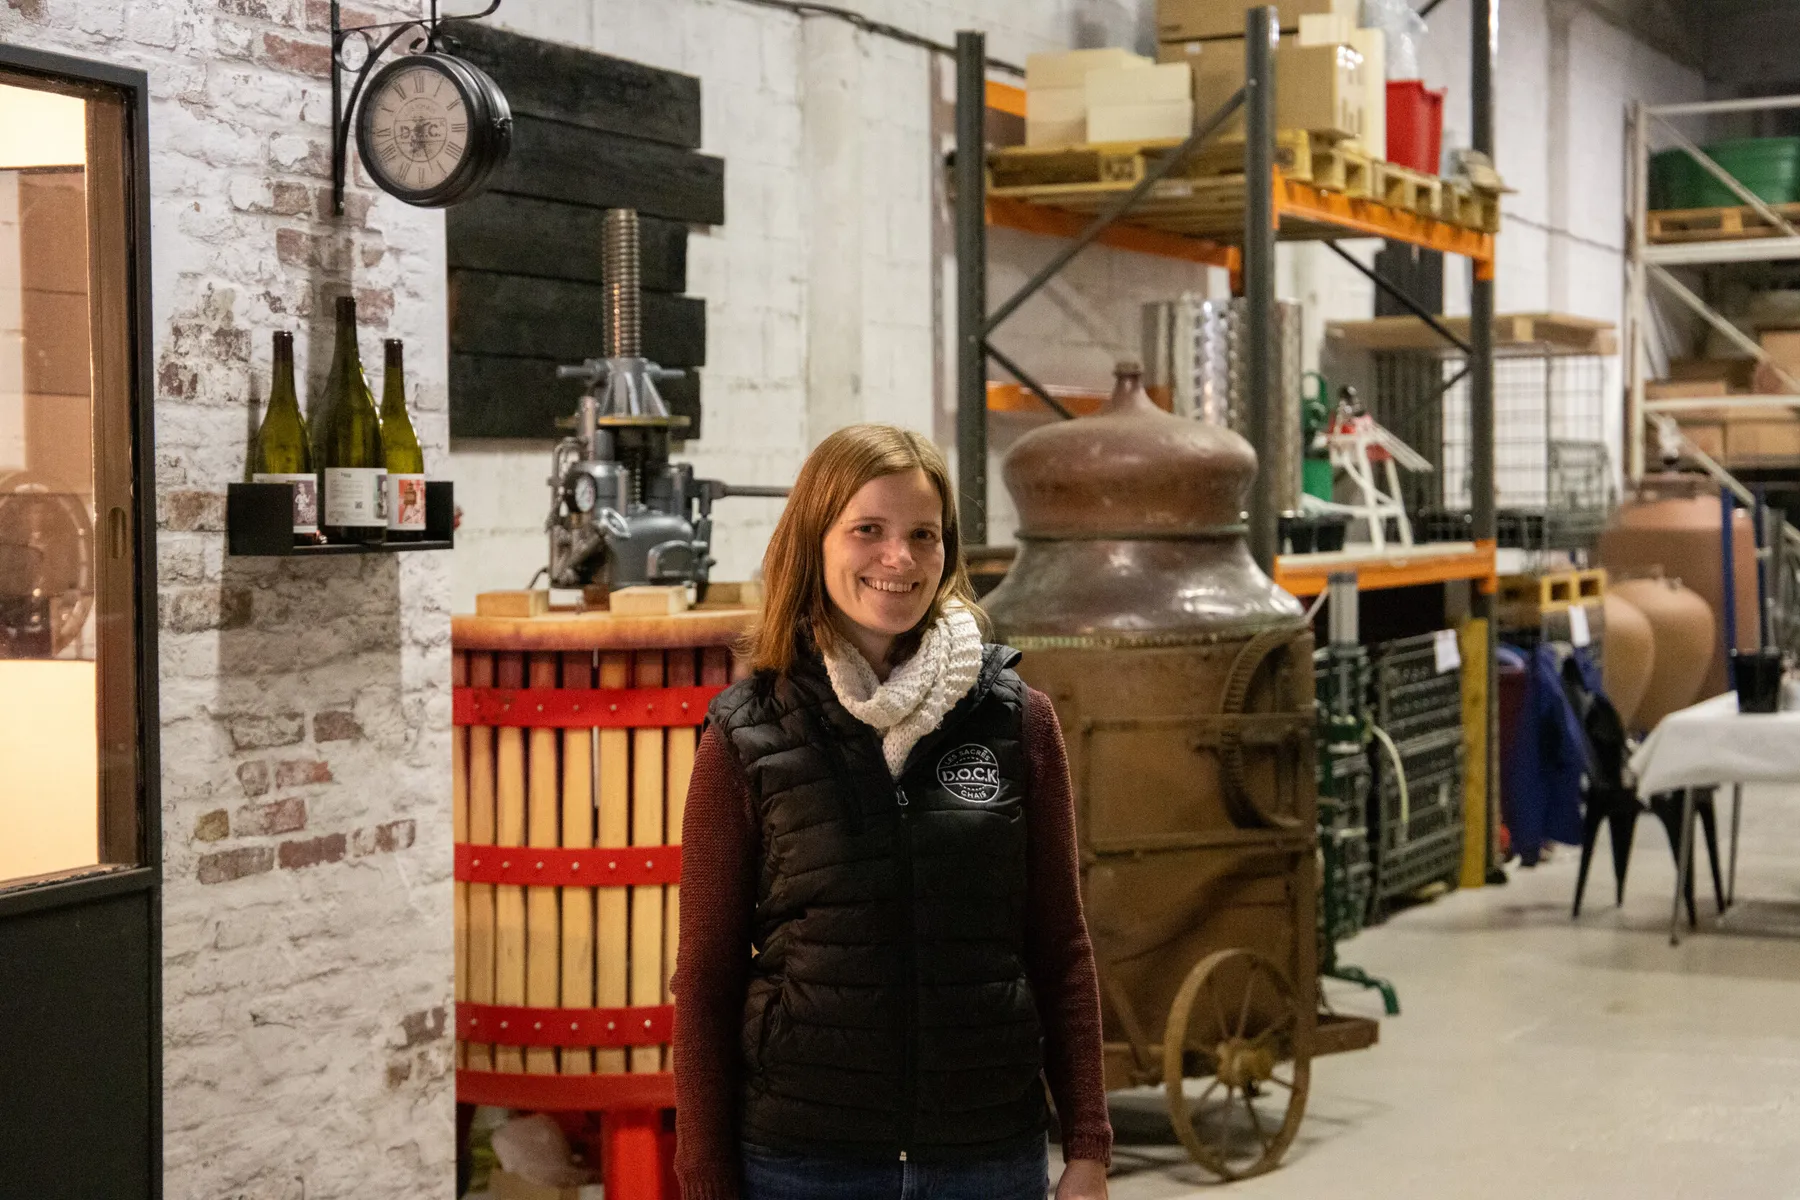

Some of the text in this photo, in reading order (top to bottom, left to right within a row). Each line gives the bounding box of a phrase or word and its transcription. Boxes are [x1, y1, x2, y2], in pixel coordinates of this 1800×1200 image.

[945, 754, 958, 765] LES
[942, 767, 998, 784] D.O.C.K
[960, 789, 988, 800] CHAIS
